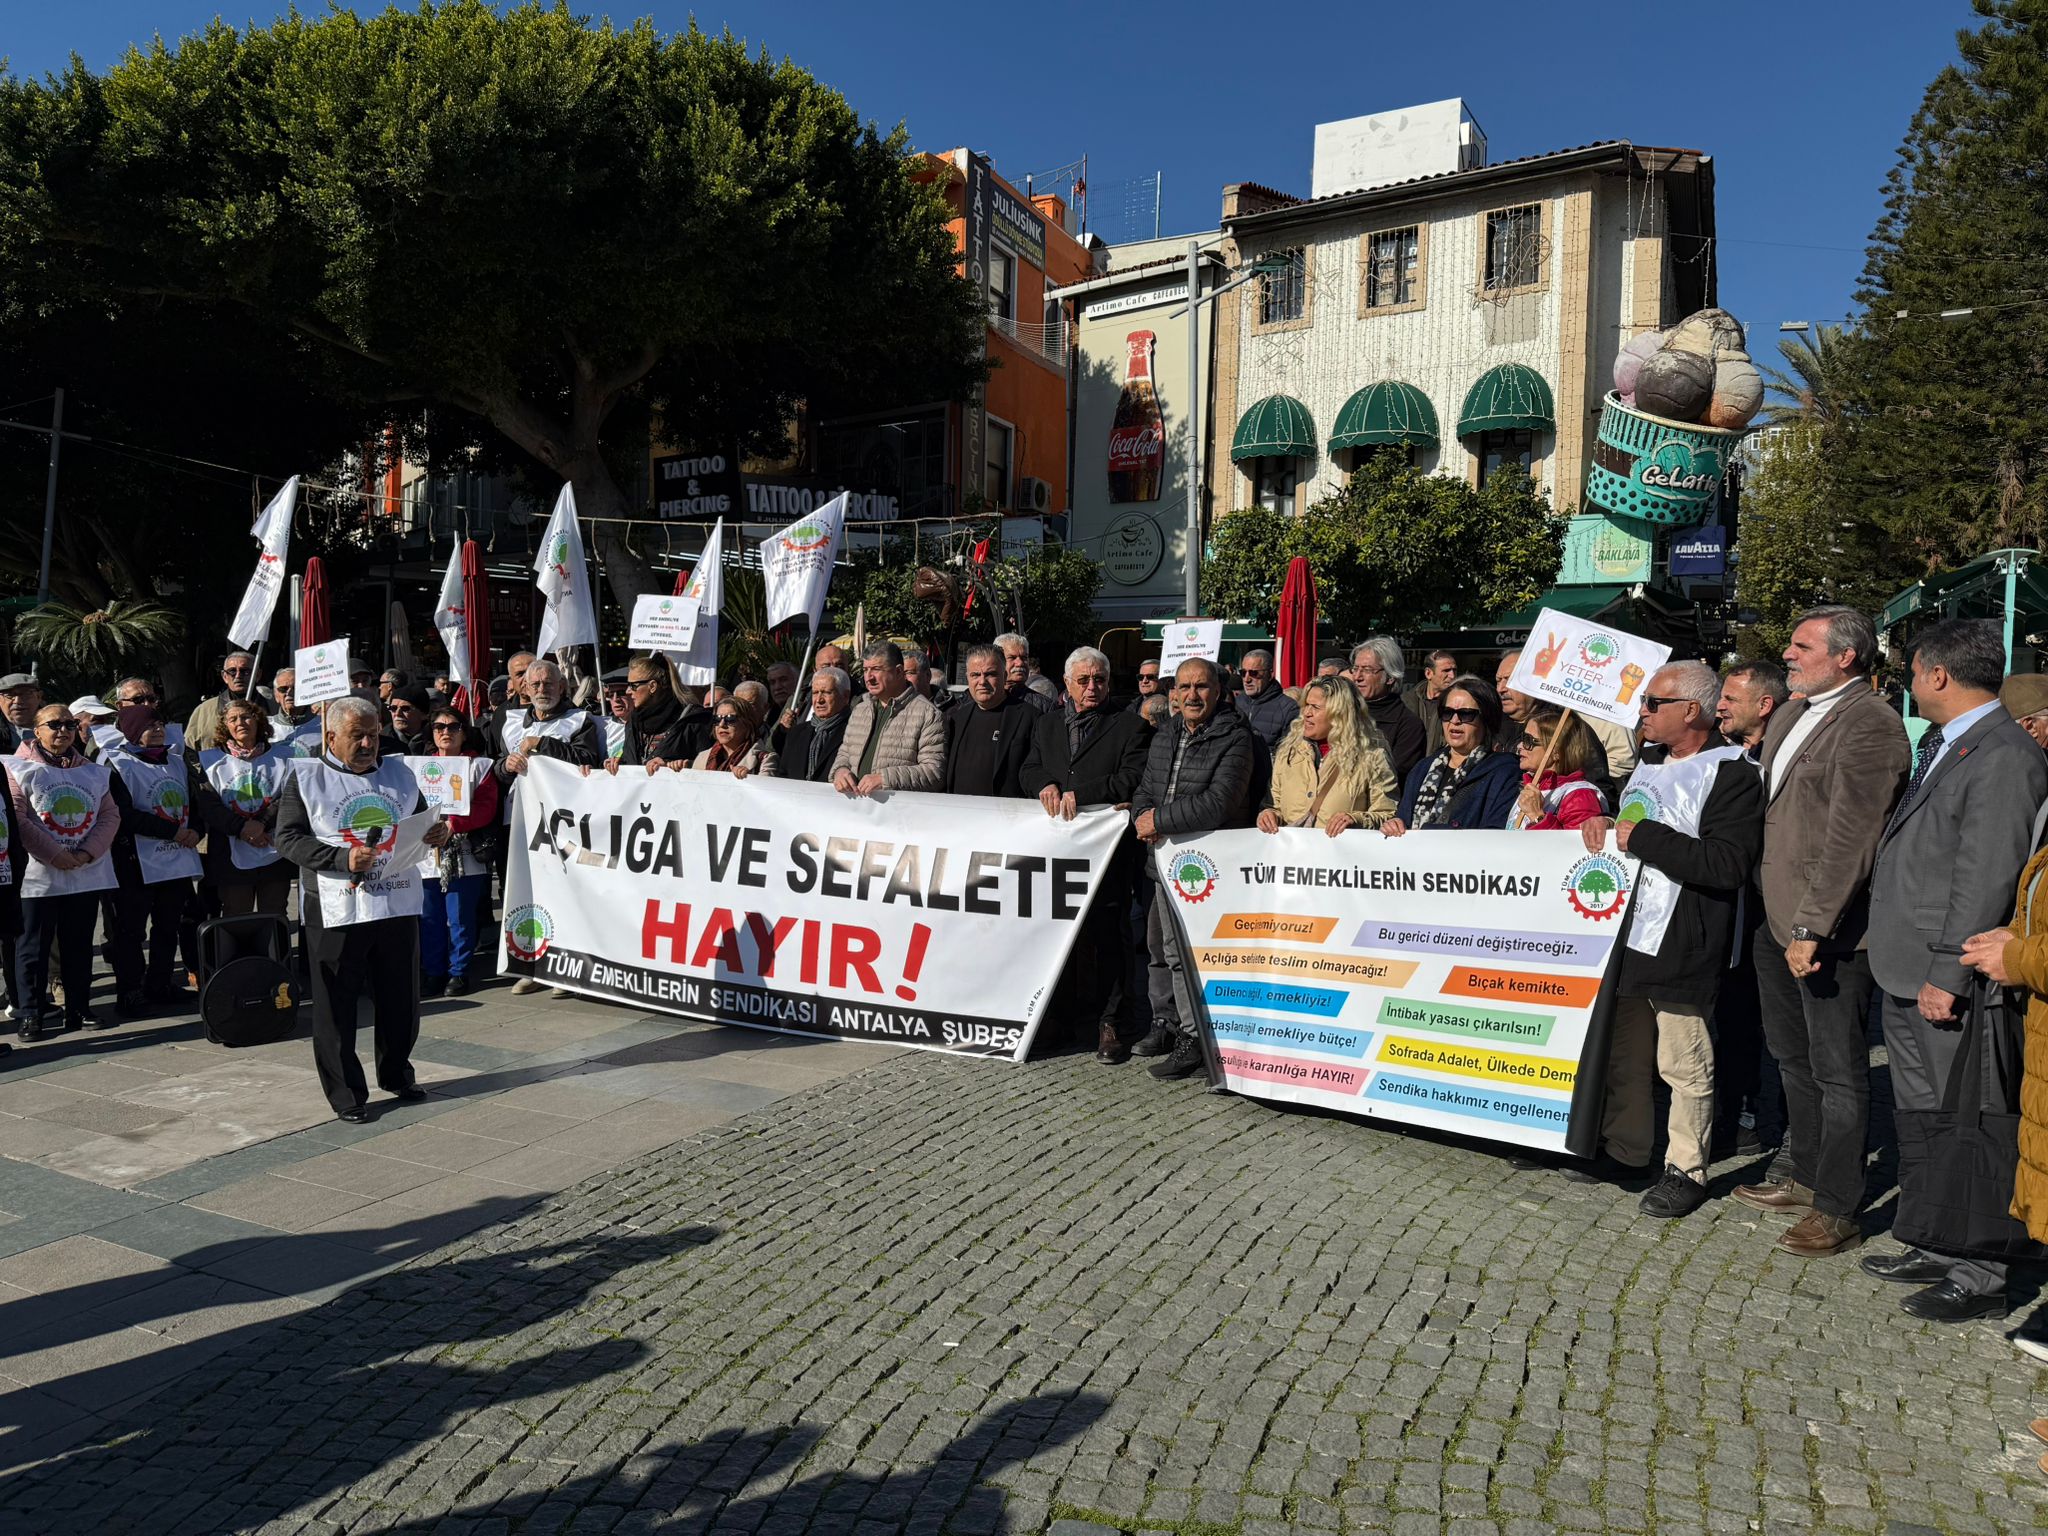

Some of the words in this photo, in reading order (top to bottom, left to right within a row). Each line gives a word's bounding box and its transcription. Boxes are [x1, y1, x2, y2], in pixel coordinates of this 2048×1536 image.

[1090, 301, 1122, 314] Artimo
[1126, 296, 1147, 306] Cafe
[662, 455, 726, 480] TATTOO
[687, 479, 702, 496] &
[746, 484, 813, 516] TATTOO
[659, 494, 731, 519] PIERCING
[1135, 549, 1153, 557] Cafe
[1597, 549, 1640, 561] BAKLAVA
[1675, 541, 1721, 554] LAVAZZA
[1563, 678, 1593, 695] SÖZ
[385, 879, 411, 891] ŞUBESİ
[706, 823, 772, 889] VE
[785, 832, 1091, 921] SEFALETE
[1239, 863, 1276, 885] TÜM
[1282, 865, 1416, 892] EMEKLİLERİN
[1422, 869, 1540, 897] SENDİKASI
[1561, 874, 1571, 891] TÜM
[1606, 853, 1632, 892] SENDİKASI
[641, 898, 932, 1002] HAYIR!
[1378, 928, 1395, 941] Bu
[1398, 929, 1431, 944] gerici
[1432, 932, 1474, 947] düzeni
[1476, 935, 1578, 957] değiştireceğiz.
[1202, 952, 1238, 966] Açlığa
[1268, 954, 1308, 969] teslim
[1311, 959, 1388, 979] olmayacağız!
[546, 951, 584, 980] TÜM
[589, 963, 700, 1006] EMEKLİLERİN
[709, 987, 818, 1025] SENDİKASI
[828, 1005, 931, 1038] ANTALYA
[1468, 974, 1505, 991] Bıçak
[1508, 977, 1569, 996] kemikte.
[1266, 990, 1332, 1008] emekliyiz!
[1386, 1002, 1426, 1022] İntibak
[1429, 1012, 1470, 1028] yasası
[1473, 1018, 1542, 1037] çıkarılsın!
[1257, 1025, 1316, 1043] emekliye
[1318, 1031, 1357, 1048] bütçe!
[1249, 1058, 1307, 1079] karanlığa
[1311, 1066, 1355, 1085] HAYIR!
[1388, 1043, 1434, 1062] Sofrada
[1437, 1051, 1482, 1071] Adalet,
[1486, 1055, 1536, 1077] Ülkede
[1378, 1078, 1428, 1099] Sendika
[1431, 1086, 1490, 1110] hakkımız
